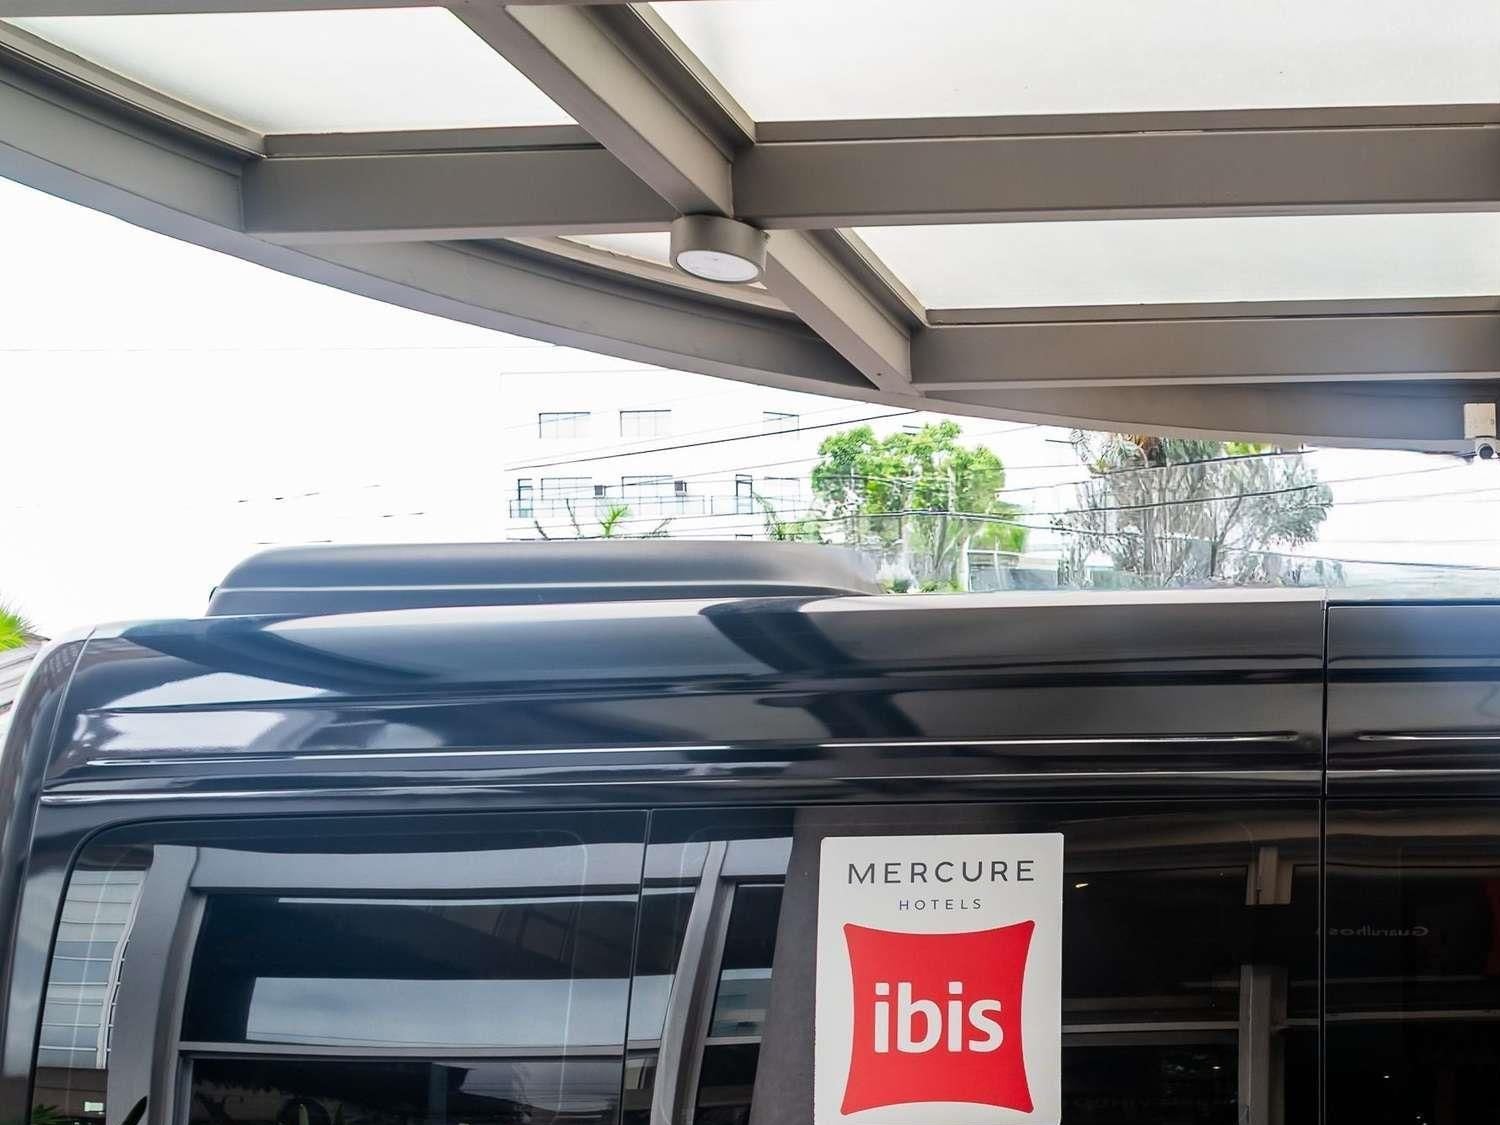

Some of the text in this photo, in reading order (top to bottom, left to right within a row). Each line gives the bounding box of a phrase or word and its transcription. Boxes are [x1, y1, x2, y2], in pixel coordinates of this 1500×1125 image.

[848, 860, 1035, 884] MERCURE
[899, 898, 982, 911] HOTELS
[873, 980, 1004, 1053] ibis
